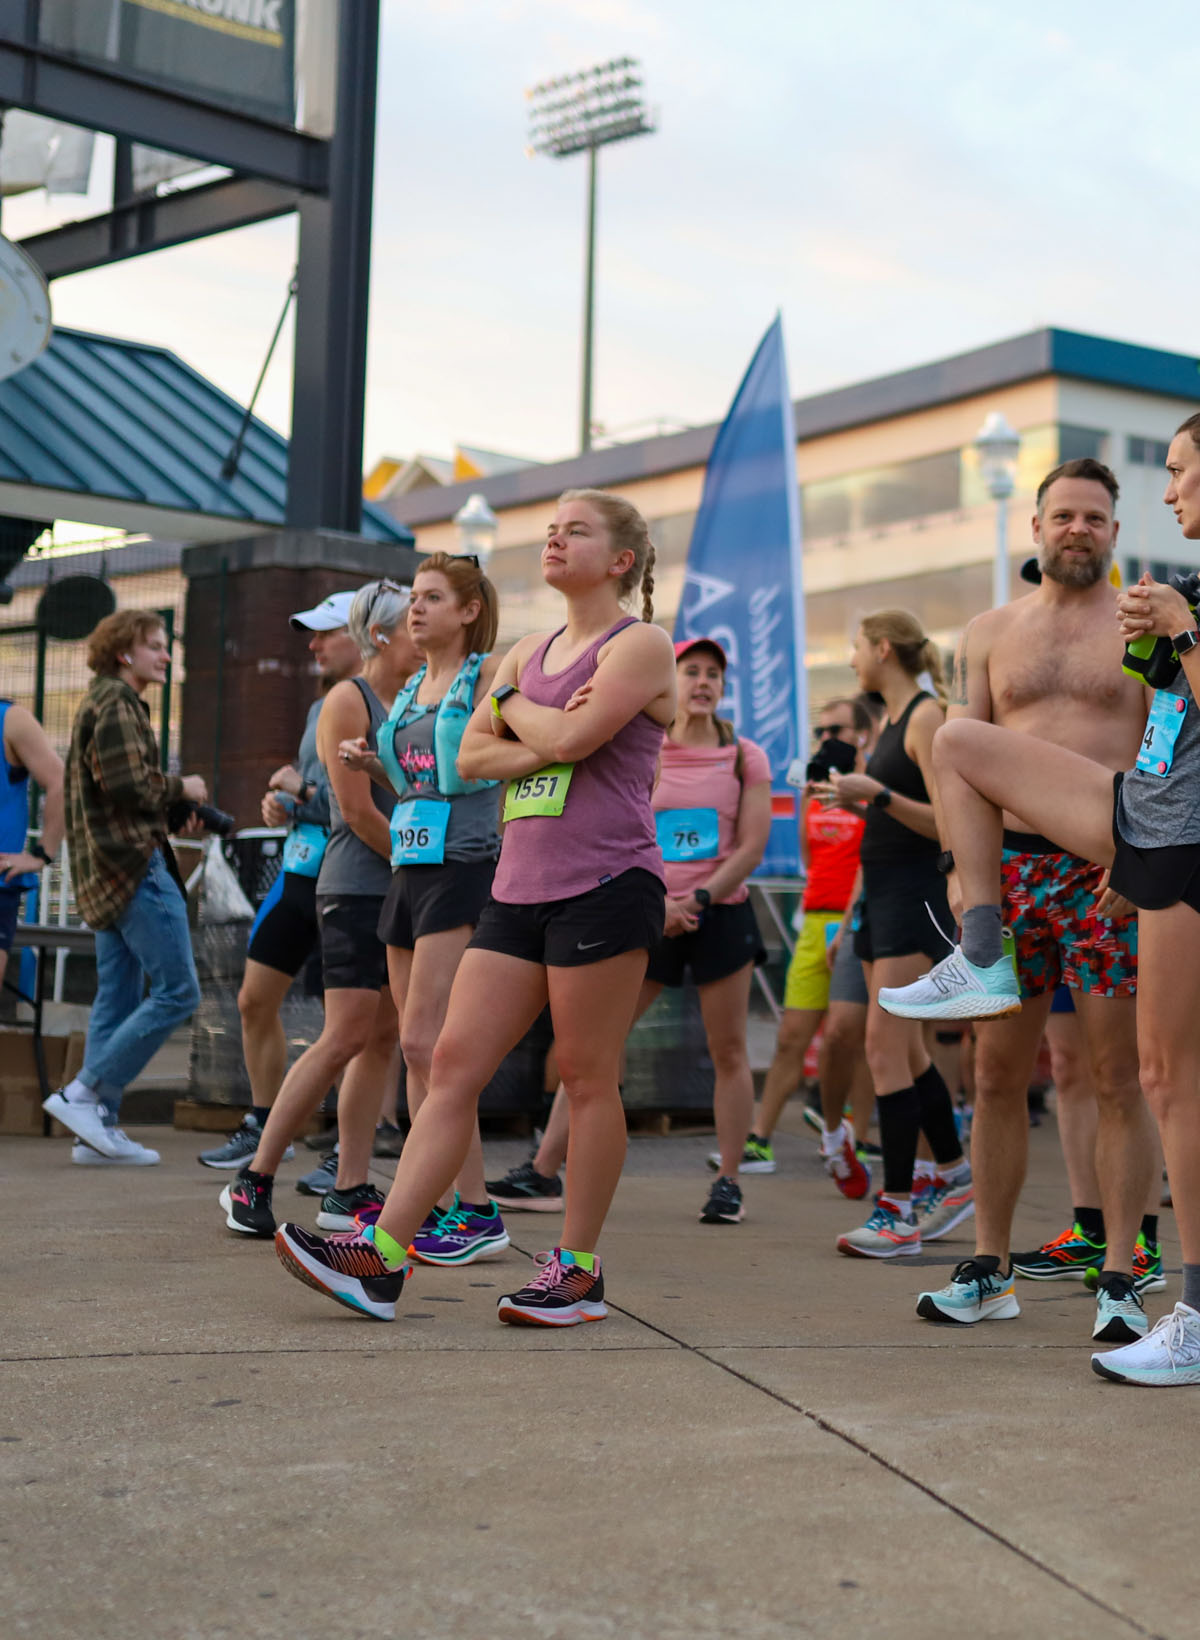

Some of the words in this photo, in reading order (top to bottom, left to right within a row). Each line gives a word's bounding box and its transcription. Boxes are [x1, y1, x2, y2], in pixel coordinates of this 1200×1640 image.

[514, 776, 559, 800] 1551
[398, 828, 429, 848] 196
[673, 831, 700, 848] 76
